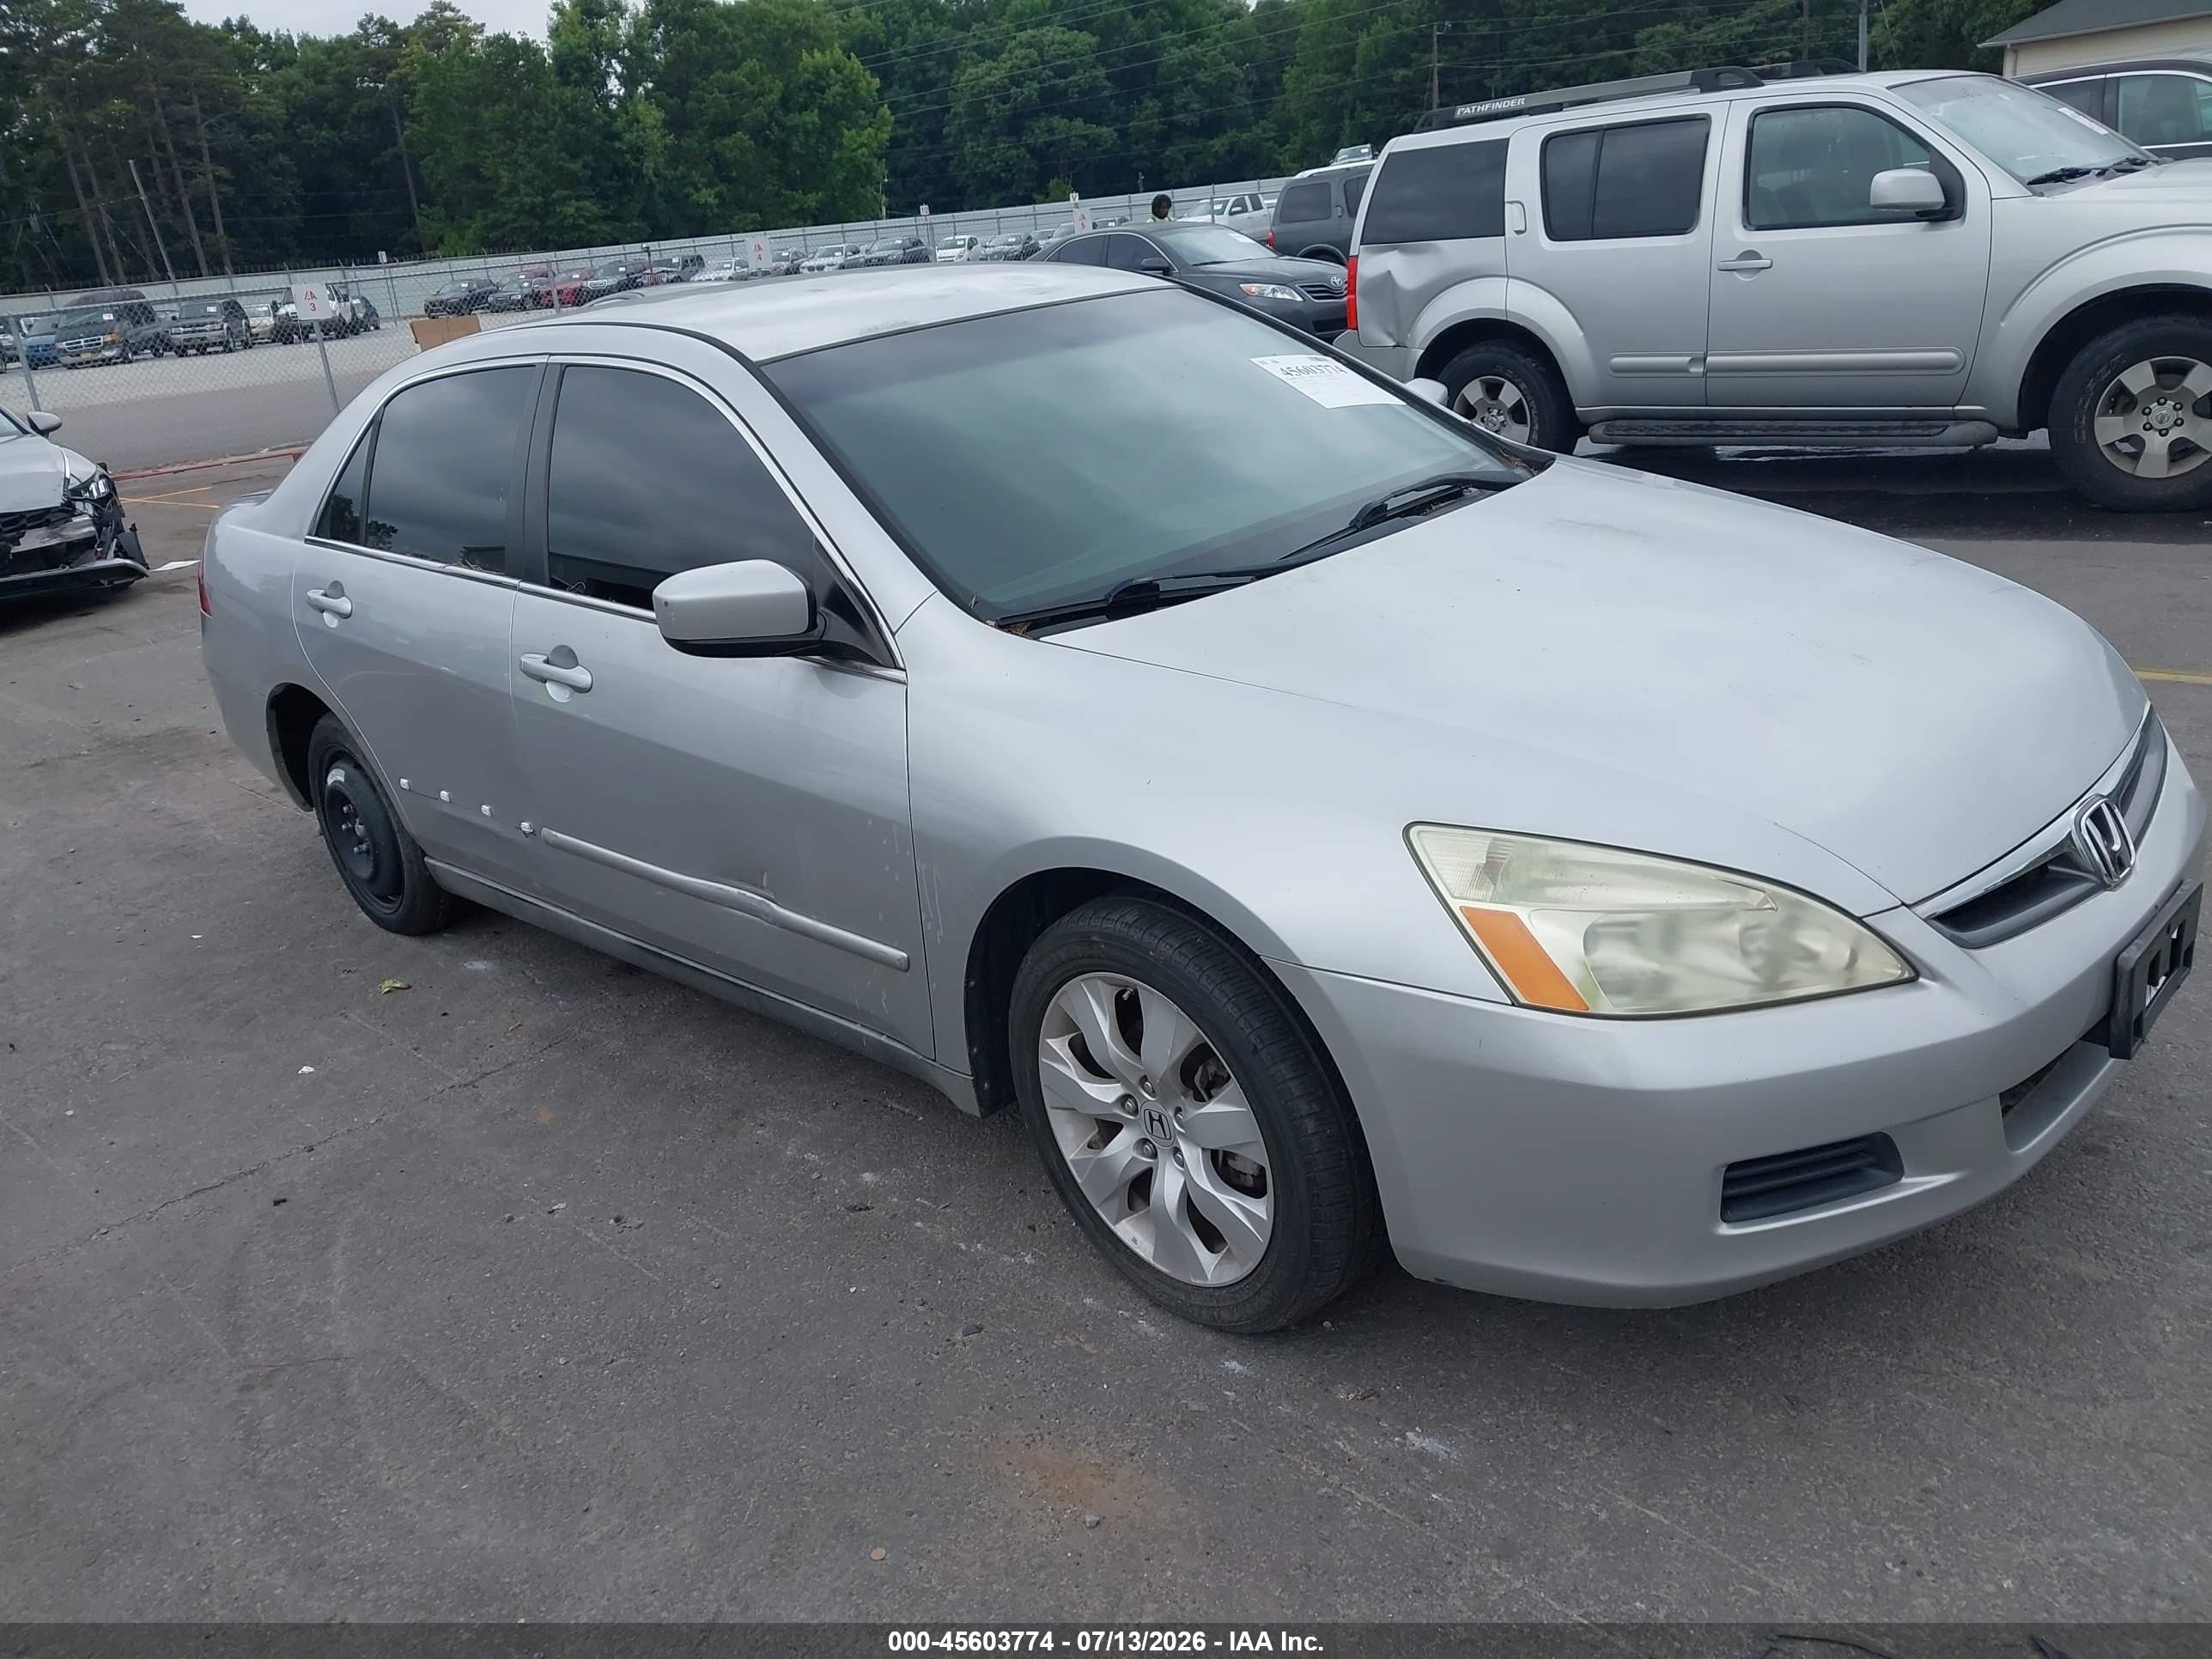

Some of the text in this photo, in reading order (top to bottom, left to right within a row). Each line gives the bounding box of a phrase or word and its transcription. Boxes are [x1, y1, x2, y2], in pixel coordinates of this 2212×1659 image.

[1457, 97, 1526, 115] PATHFINDER
[309, 302, 317, 312] 3
[1279, 364, 1348, 376] 45603774
